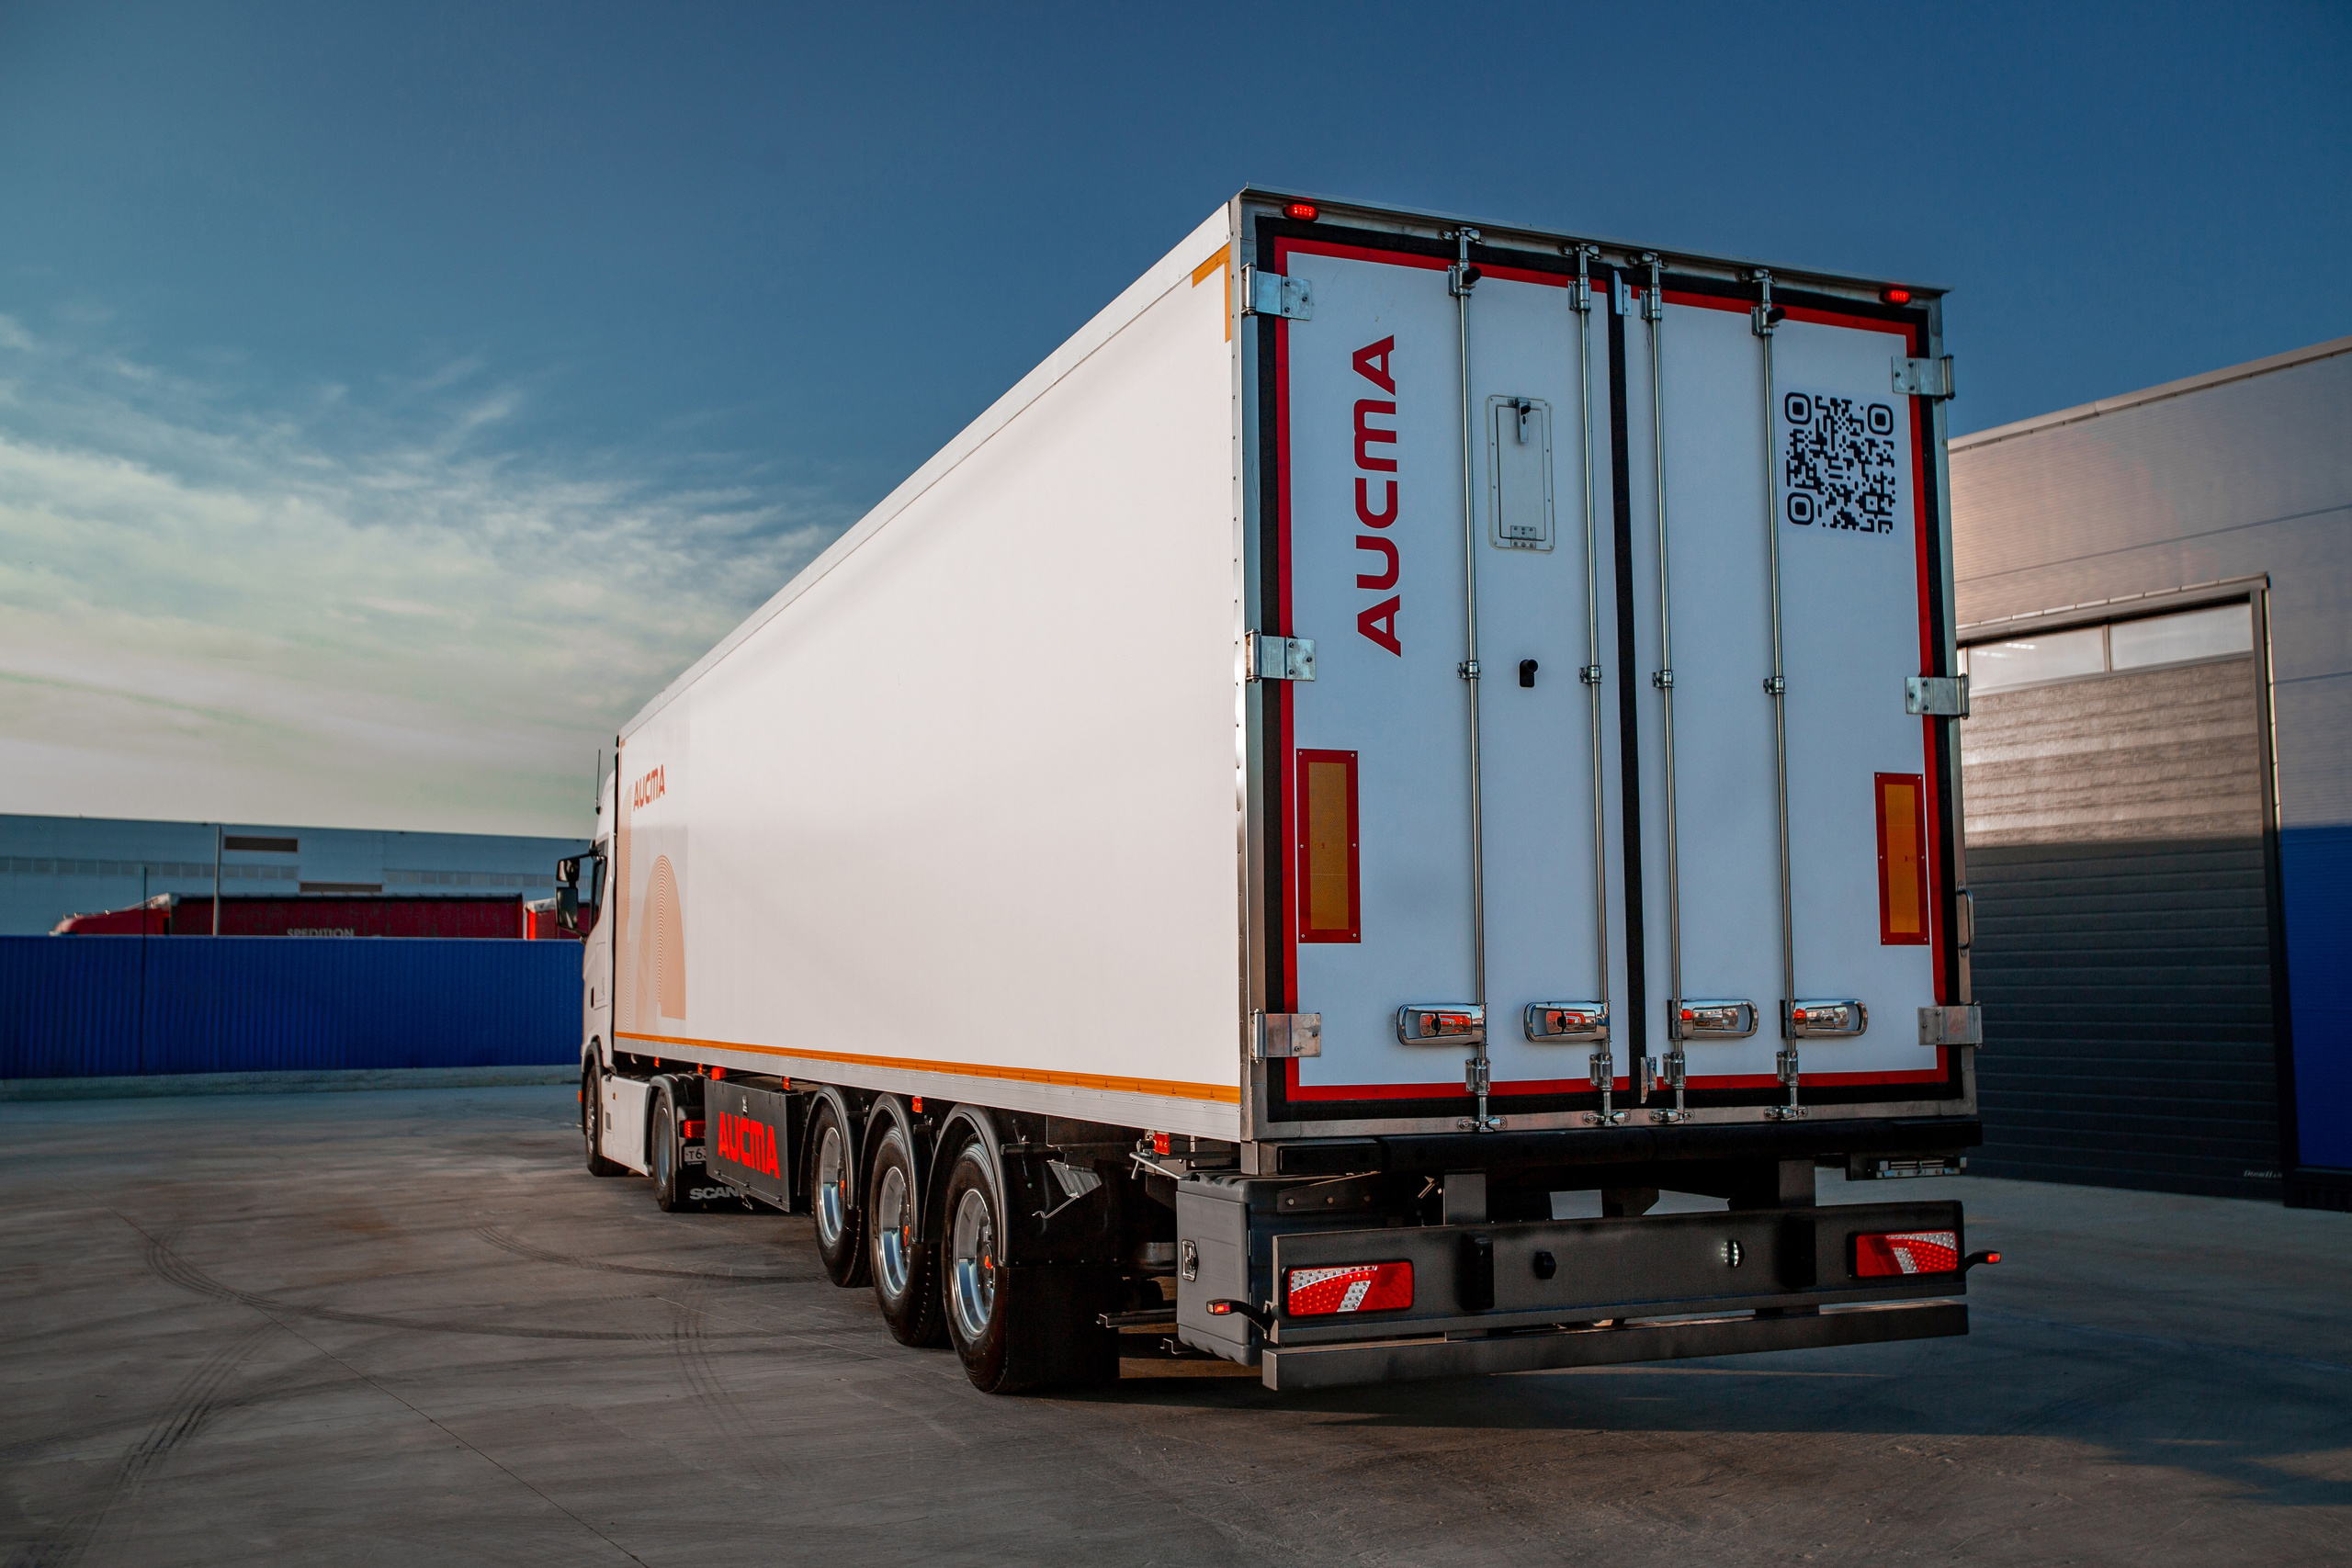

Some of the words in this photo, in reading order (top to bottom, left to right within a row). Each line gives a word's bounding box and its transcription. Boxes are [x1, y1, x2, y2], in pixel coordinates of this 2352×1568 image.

[1352, 333, 1402, 659] AUCMA
[633, 763, 666, 812] AUCMA
[287, 928, 355, 938] SPEDITION
[688, 1147, 707, 1160] T6
[718, 1111, 781, 1179] AUCMA
[689, 1186, 741, 1201] SCAN
